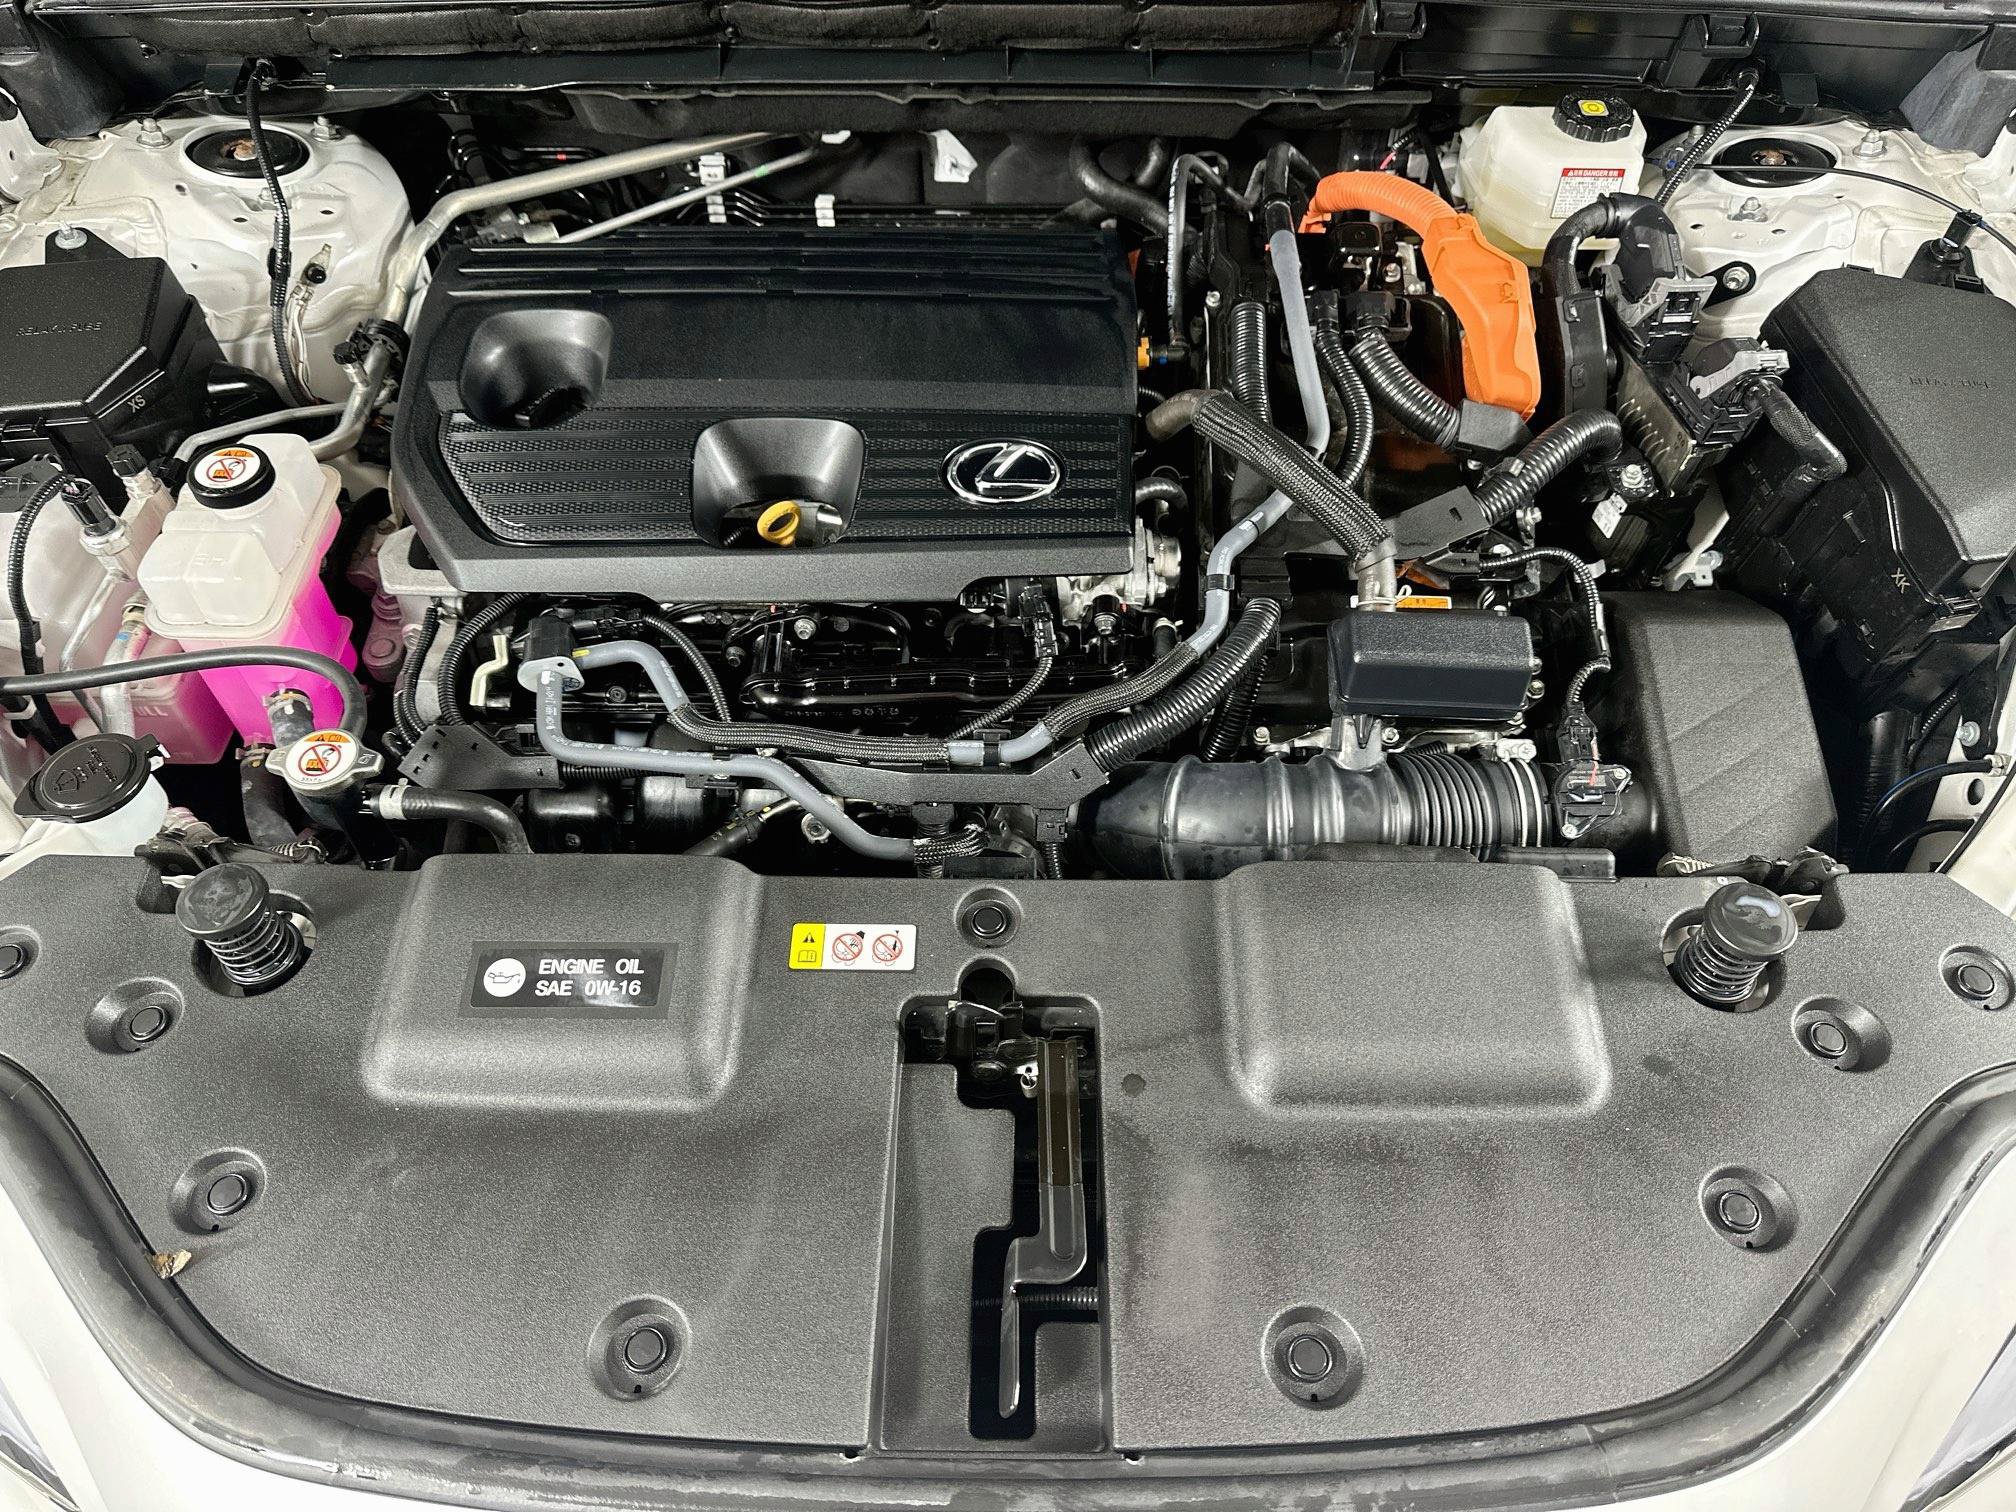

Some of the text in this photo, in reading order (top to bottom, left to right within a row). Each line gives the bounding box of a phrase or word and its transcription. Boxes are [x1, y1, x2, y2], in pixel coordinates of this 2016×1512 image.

[1584, 169, 1609, 177] DANGER
[127, 394, 146, 413] XS
[1890, 567, 1911, 594] XK
[538, 957, 645, 975] ENGINE OIL
[534, 979, 642, 996] SAE 0W-16
